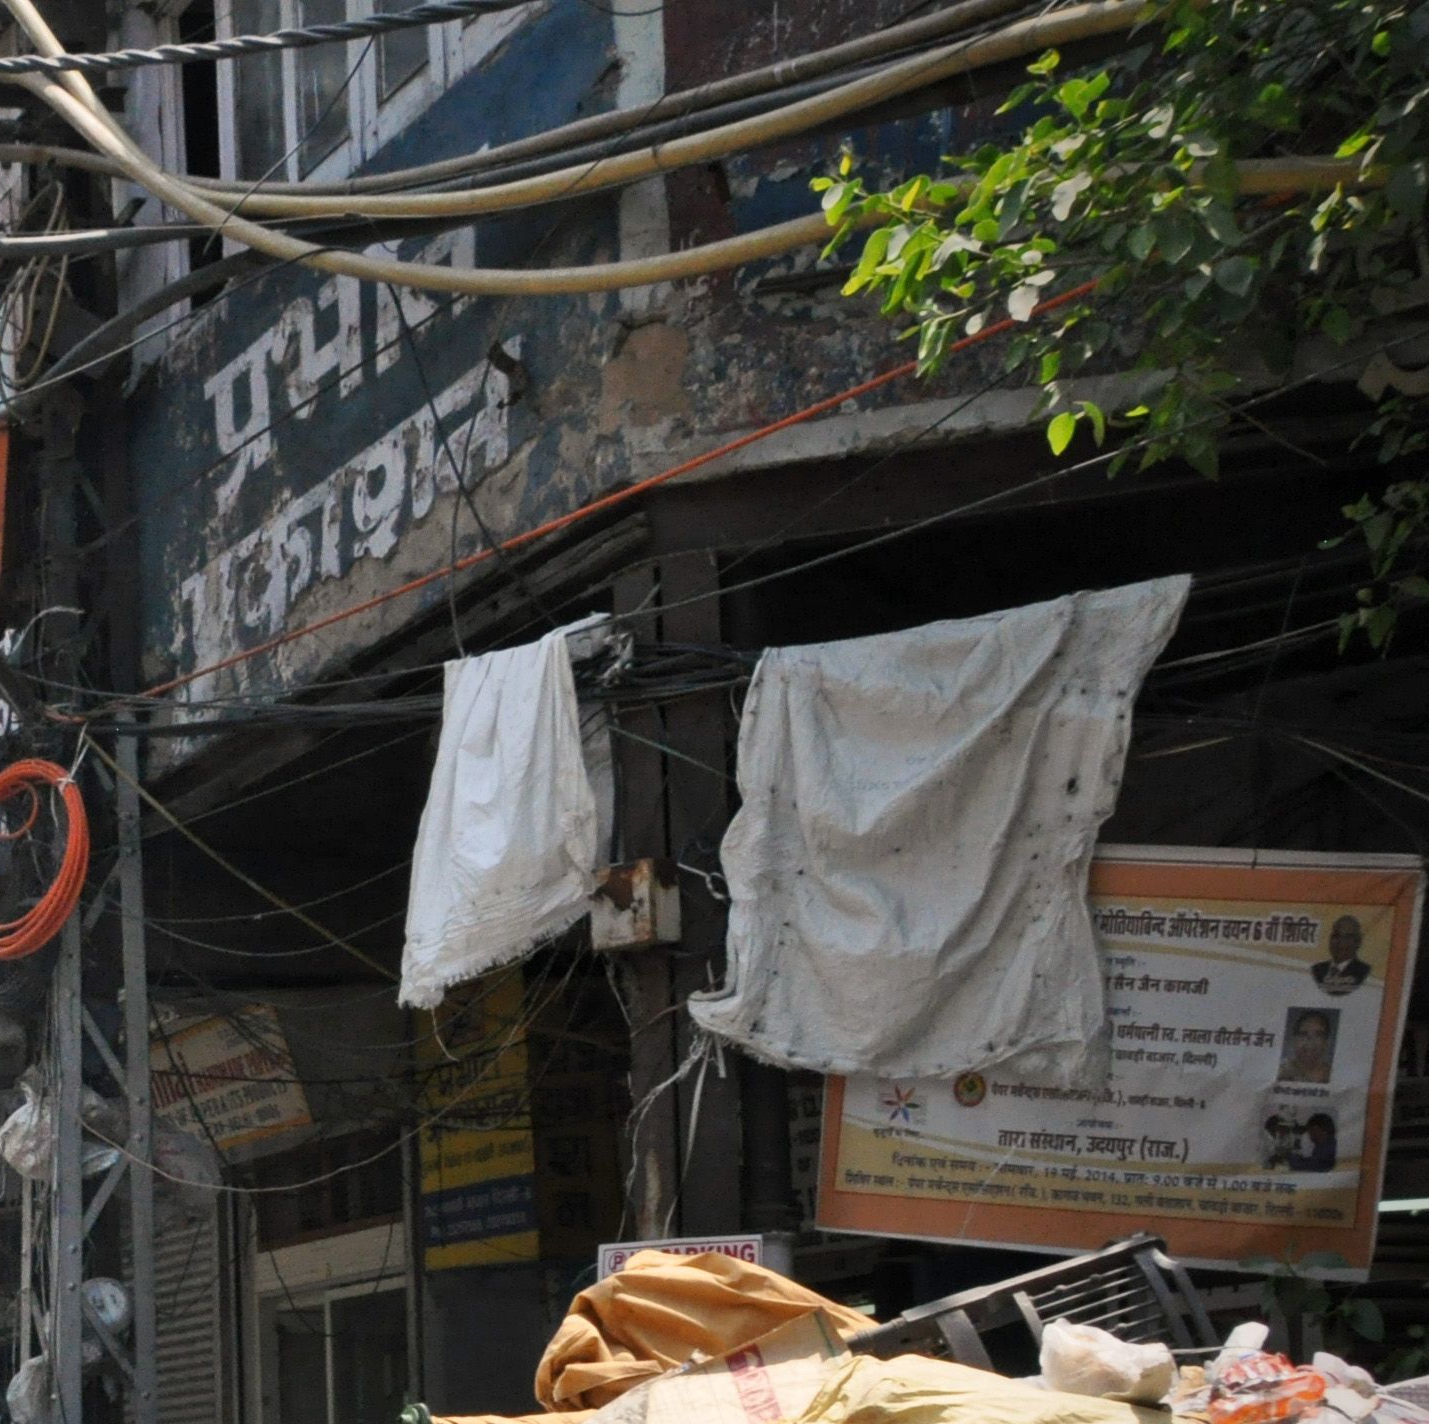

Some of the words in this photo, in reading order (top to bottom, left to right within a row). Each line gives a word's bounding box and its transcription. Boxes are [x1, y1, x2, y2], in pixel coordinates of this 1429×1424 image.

[997, 1127, 1026, 1147] तारा
[1029, 1128, 1083, 1156] संस्थान,
[1085, 1134, 1137, 1161] उदयपुर
[1138, 1135, 1189, 1164] (राज.)
